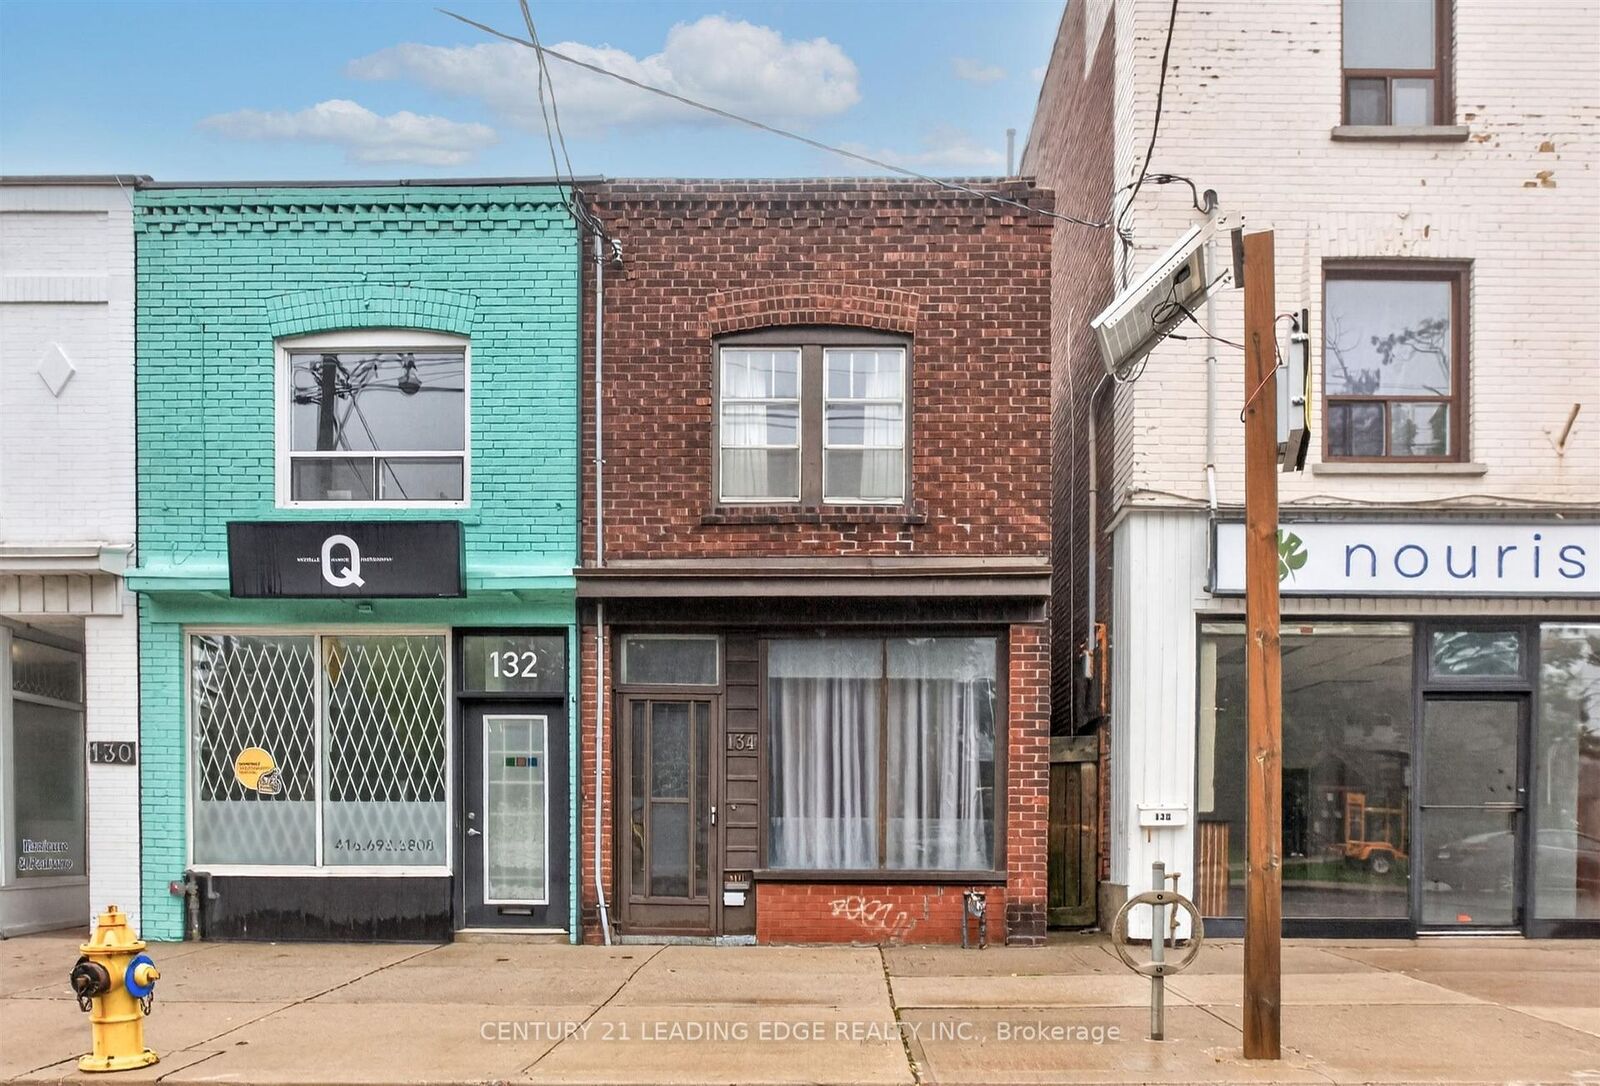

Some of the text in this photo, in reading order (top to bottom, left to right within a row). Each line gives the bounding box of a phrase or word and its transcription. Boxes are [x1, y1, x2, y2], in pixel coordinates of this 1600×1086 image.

[321, 534, 365, 588] Q
[1345, 533, 1586, 579] nouris
[490, 651, 538, 678] 132
[92, 743, 132, 762] 130
[727, 733, 754, 750] 134
